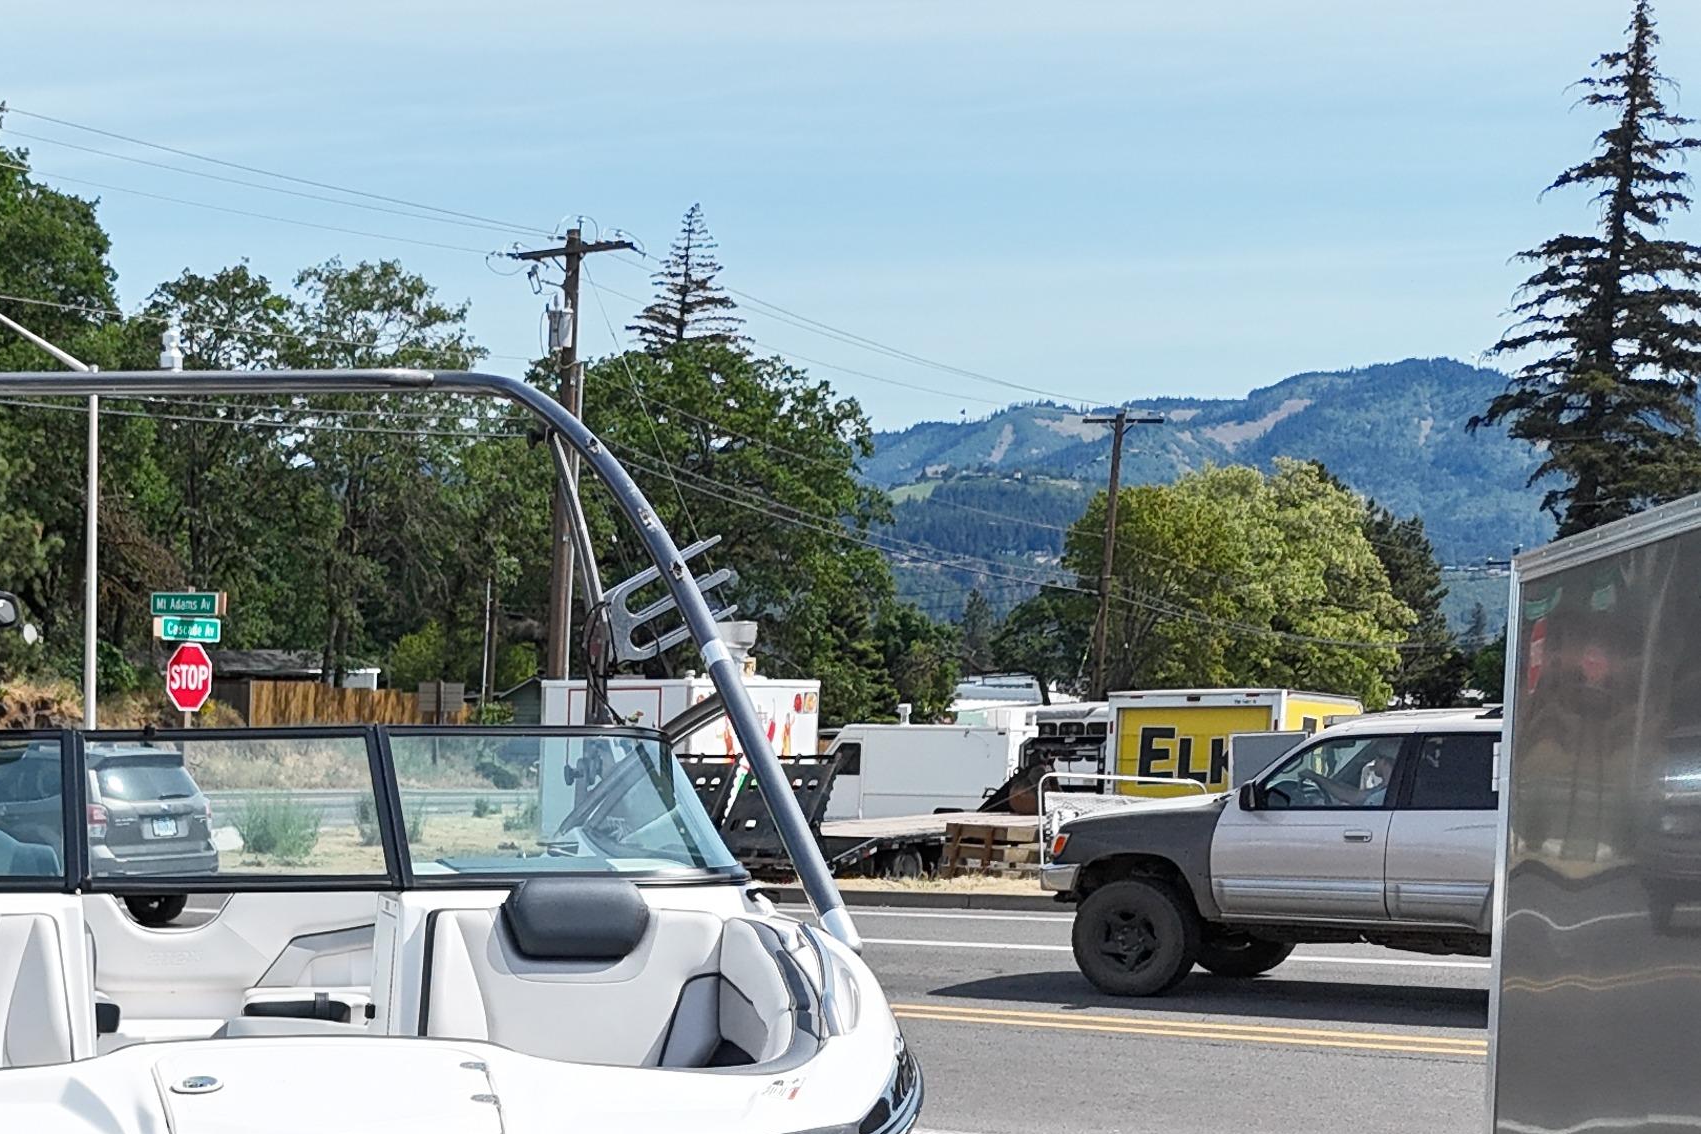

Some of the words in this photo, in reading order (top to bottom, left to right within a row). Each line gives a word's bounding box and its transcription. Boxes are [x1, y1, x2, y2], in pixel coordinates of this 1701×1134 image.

[169, 598, 198, 611] Adams
[200, 598, 211, 610] Av
[167, 621, 203, 637] Cascade
[204, 624, 215, 637] Av
[170, 664, 209, 690] STOP
